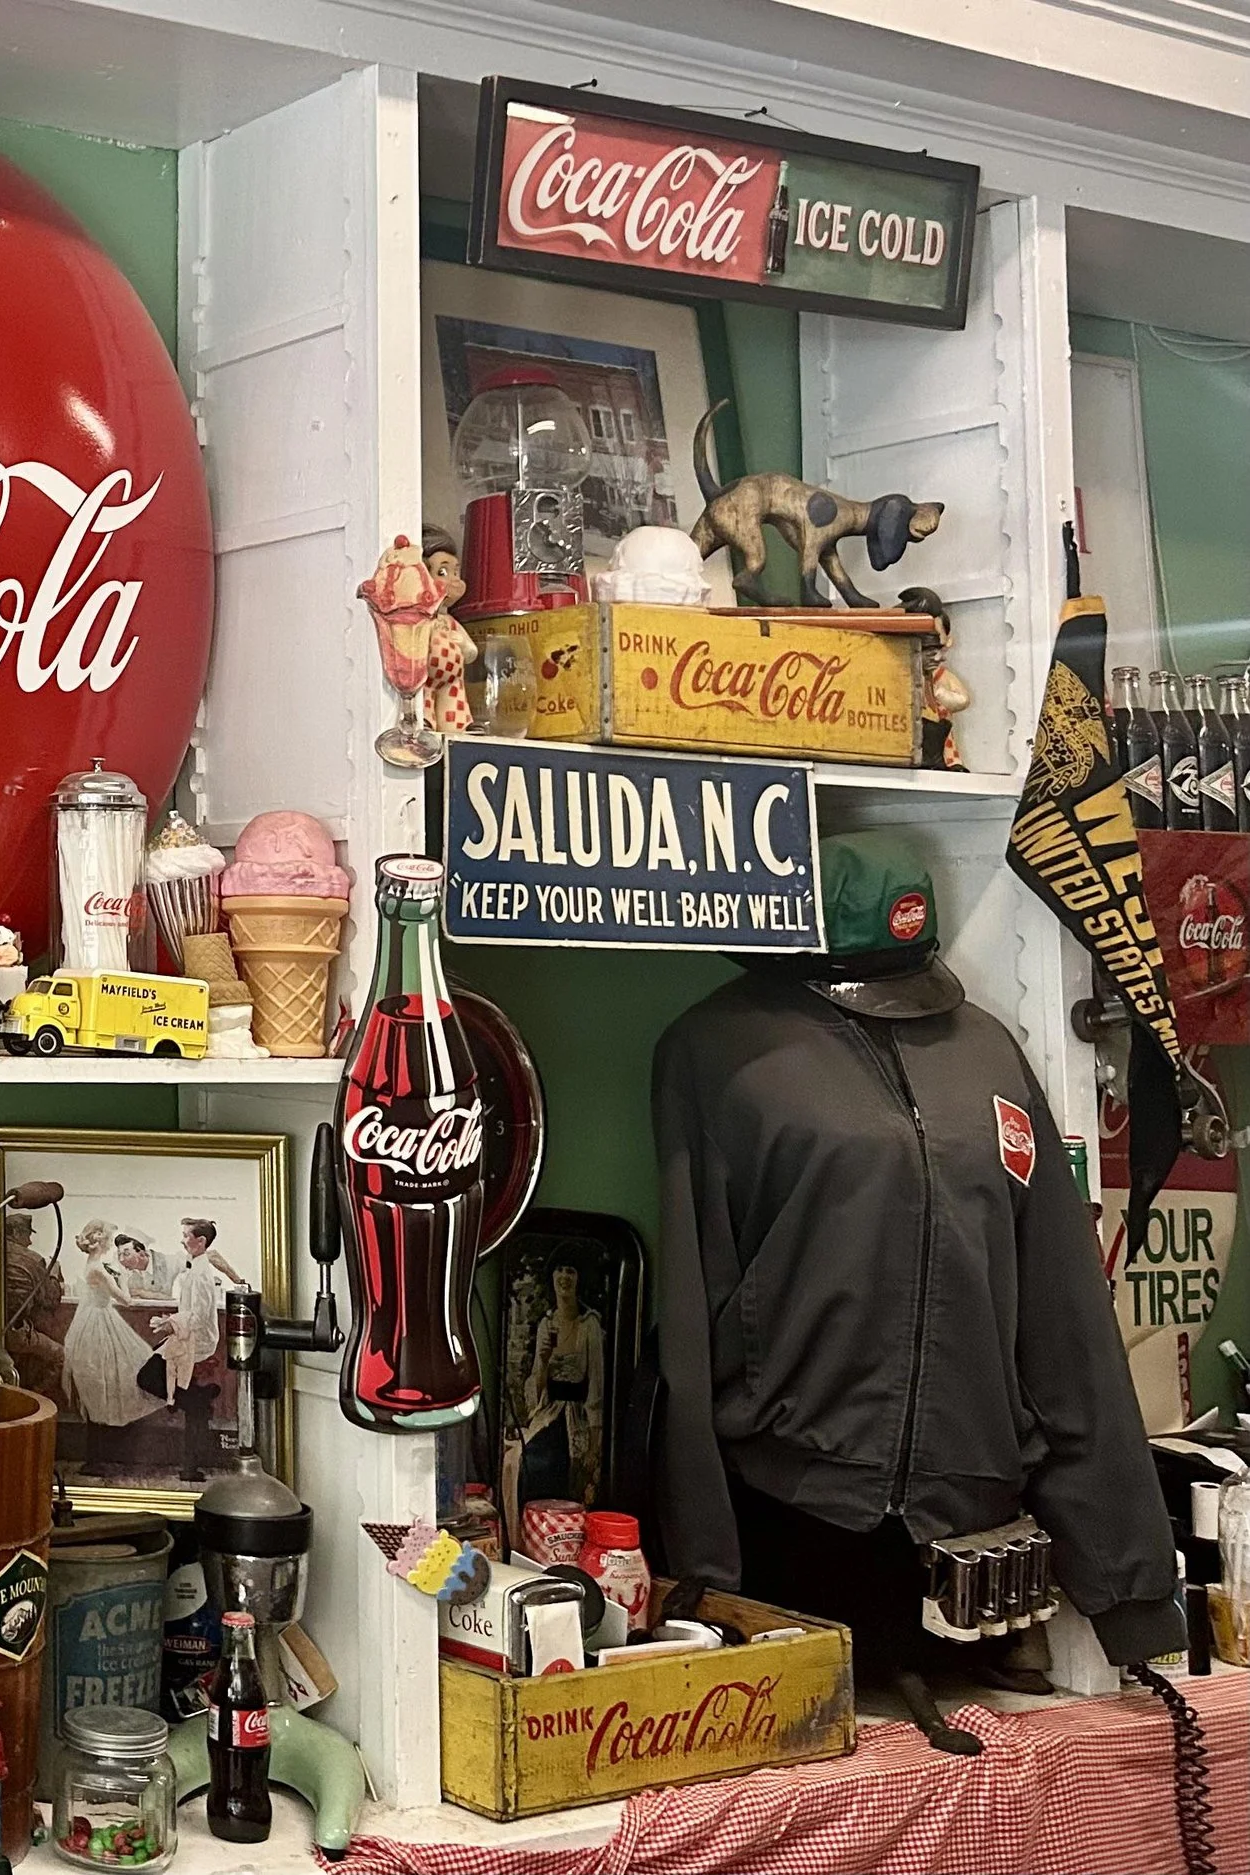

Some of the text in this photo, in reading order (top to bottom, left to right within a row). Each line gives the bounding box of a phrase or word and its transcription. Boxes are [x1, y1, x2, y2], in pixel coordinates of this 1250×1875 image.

[507, 125, 764, 263] Coca-Cola
[795, 198, 946, 266] ICE COLD
[619, 631, 678, 656] DRINK
[669, 640, 850, 724] Coca-Cola
[868, 686, 886, 707] IN
[536, 693, 576, 714] Coke
[847, 709, 908, 733] BOTTLES
[462, 762, 806, 877] SALUDA, N.C.
[535, 885, 604, 924] YOUR
[611, 887, 676, 927] WELL
[680, 891, 741, 930] BABY
[1011, 800, 1110, 911] UNITED
[1083, 908, 1164, 1015] STATES
[1179, 914, 1245, 950] Coca-Cola
[101, 984, 157, 1000] MAYFIELD'S
[153, 1016, 204, 1031] ICE CREAM
[344, 1098, 483, 1175] Coca-Cola
[496, 1121, 504, 1135] 3
[1125, 1268, 1220, 1327] TIRES
[449, 1604, 493, 1637] Coke
[526, 1706, 593, 1740] DRINK
[586, 1673, 783, 1780] Coca-Cola
